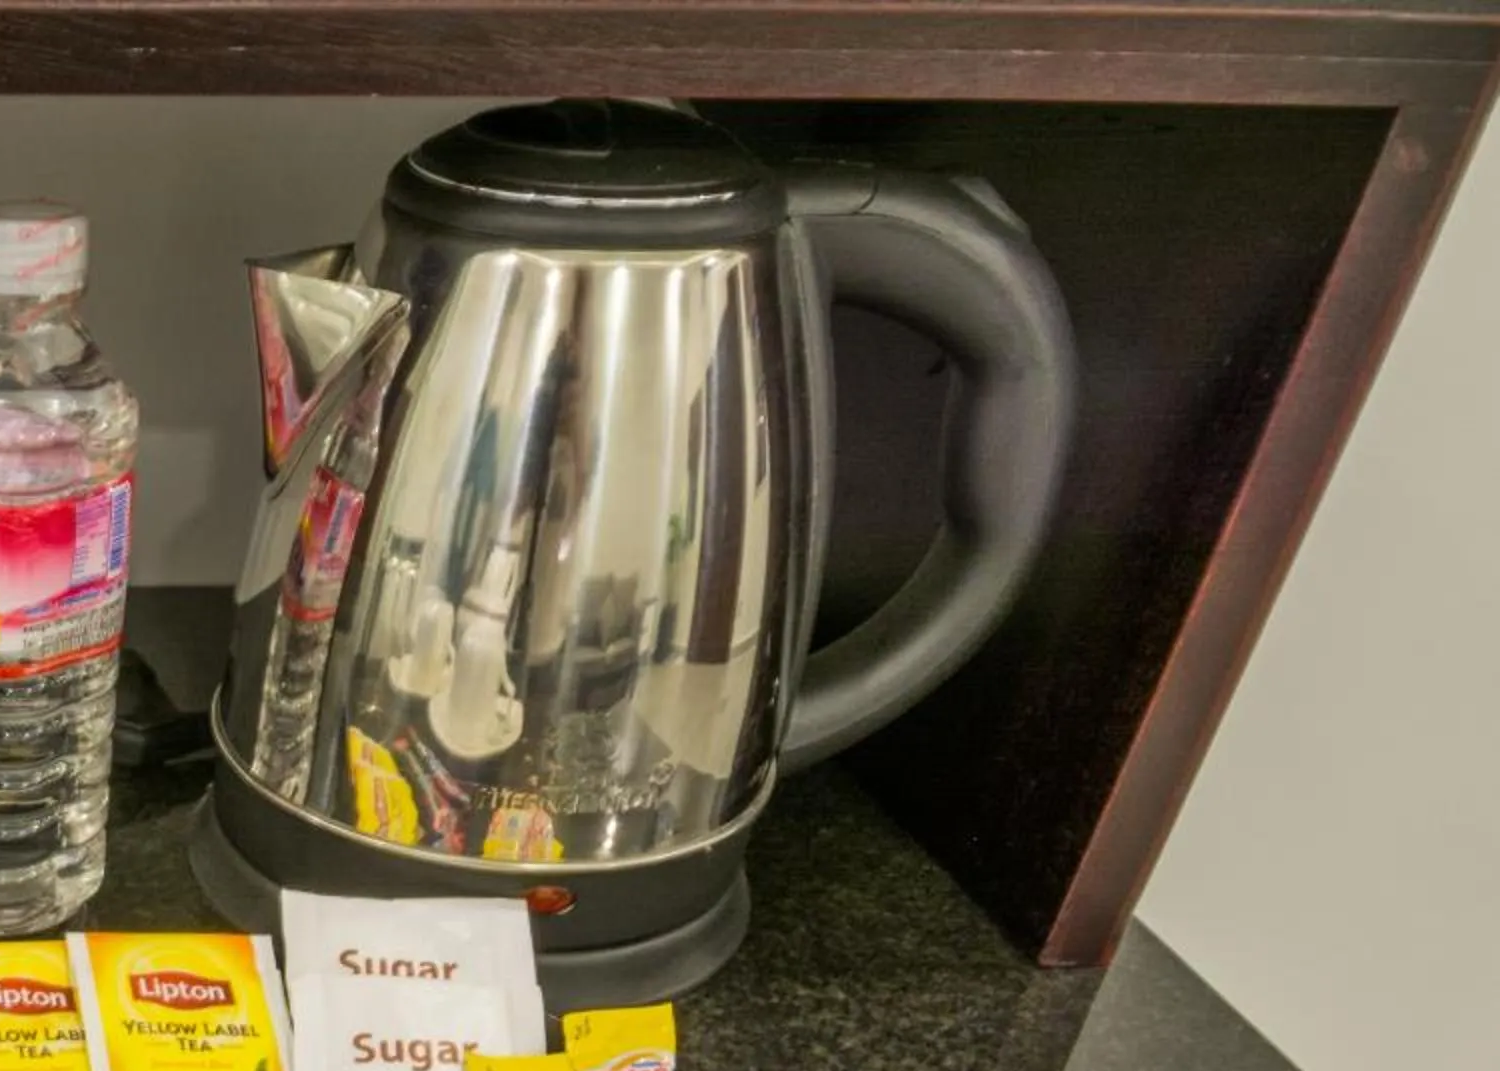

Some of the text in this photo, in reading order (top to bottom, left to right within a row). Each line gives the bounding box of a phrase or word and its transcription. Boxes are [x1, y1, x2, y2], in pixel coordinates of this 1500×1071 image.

[138, 977, 226, 1002] Lipton
[44, 1027, 87, 1042] LAB
[122, 1020, 260, 1037] YELLOW LABEL
[15, 1045, 53, 1059] TEA
[177, 1038, 214, 1052] TEA
